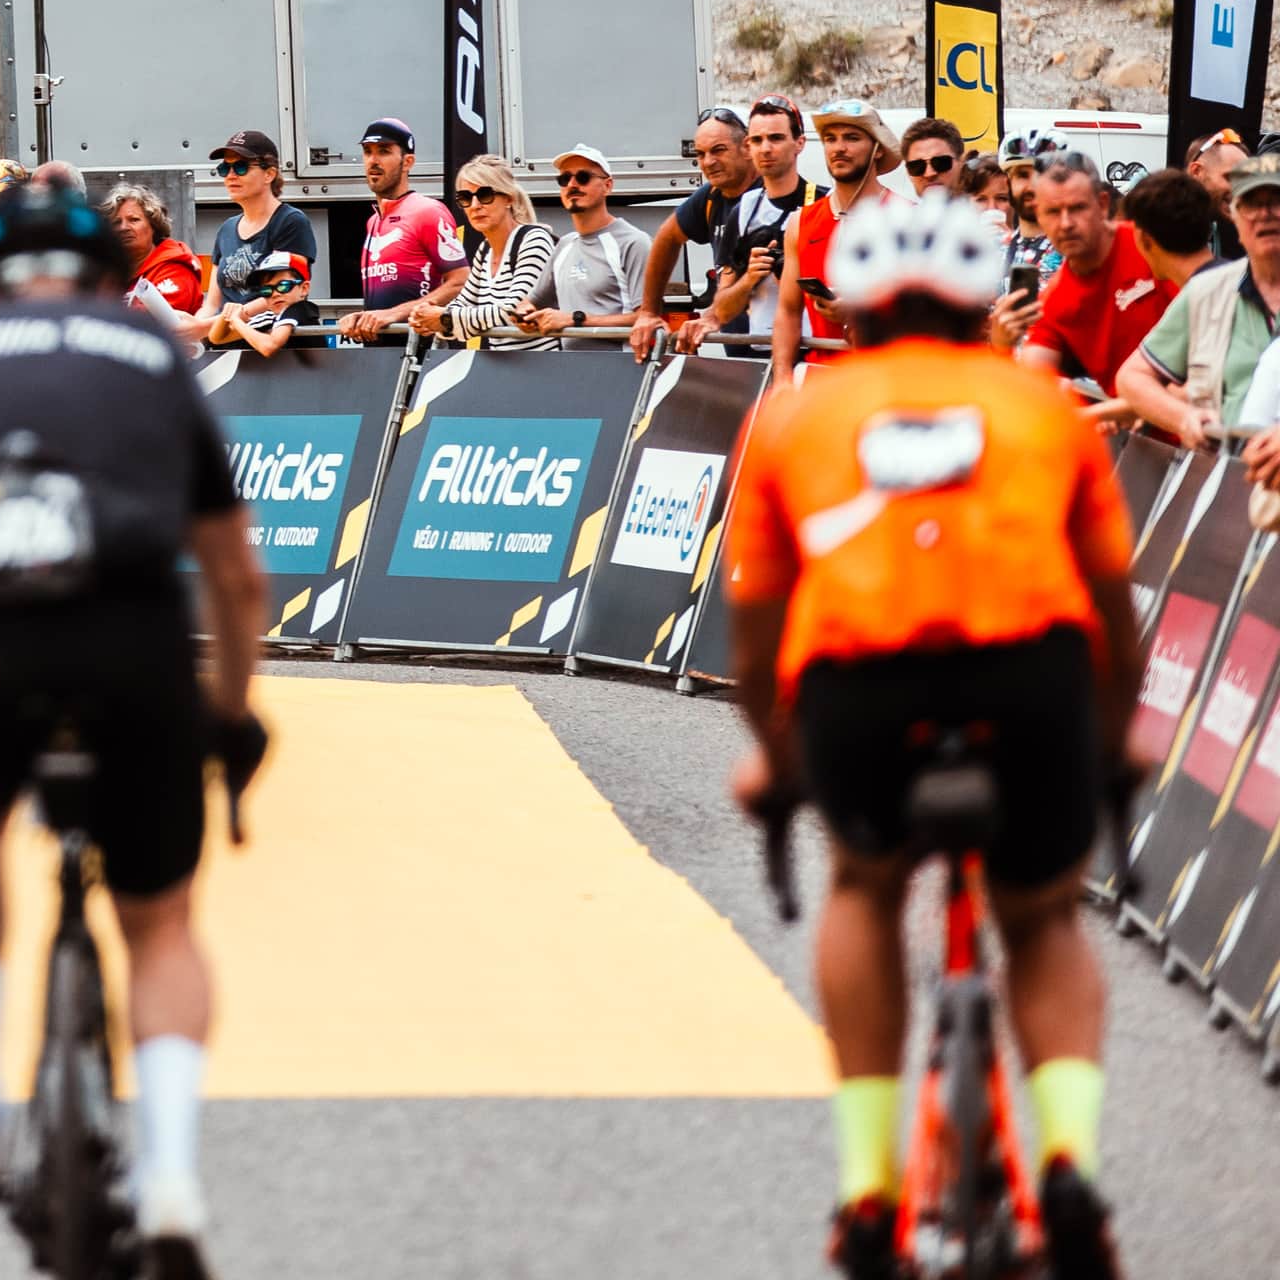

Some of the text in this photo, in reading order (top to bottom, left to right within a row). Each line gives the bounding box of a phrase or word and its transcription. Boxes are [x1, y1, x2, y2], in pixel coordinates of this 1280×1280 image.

[938, 39, 994, 94] LCL
[223, 442, 344, 502] lltricks
[417, 444, 582, 508] Alltricks
[273, 527, 319, 547] OUTDOOR
[412, 524, 553, 554] VÉLO RUNNING OUTDOOR
